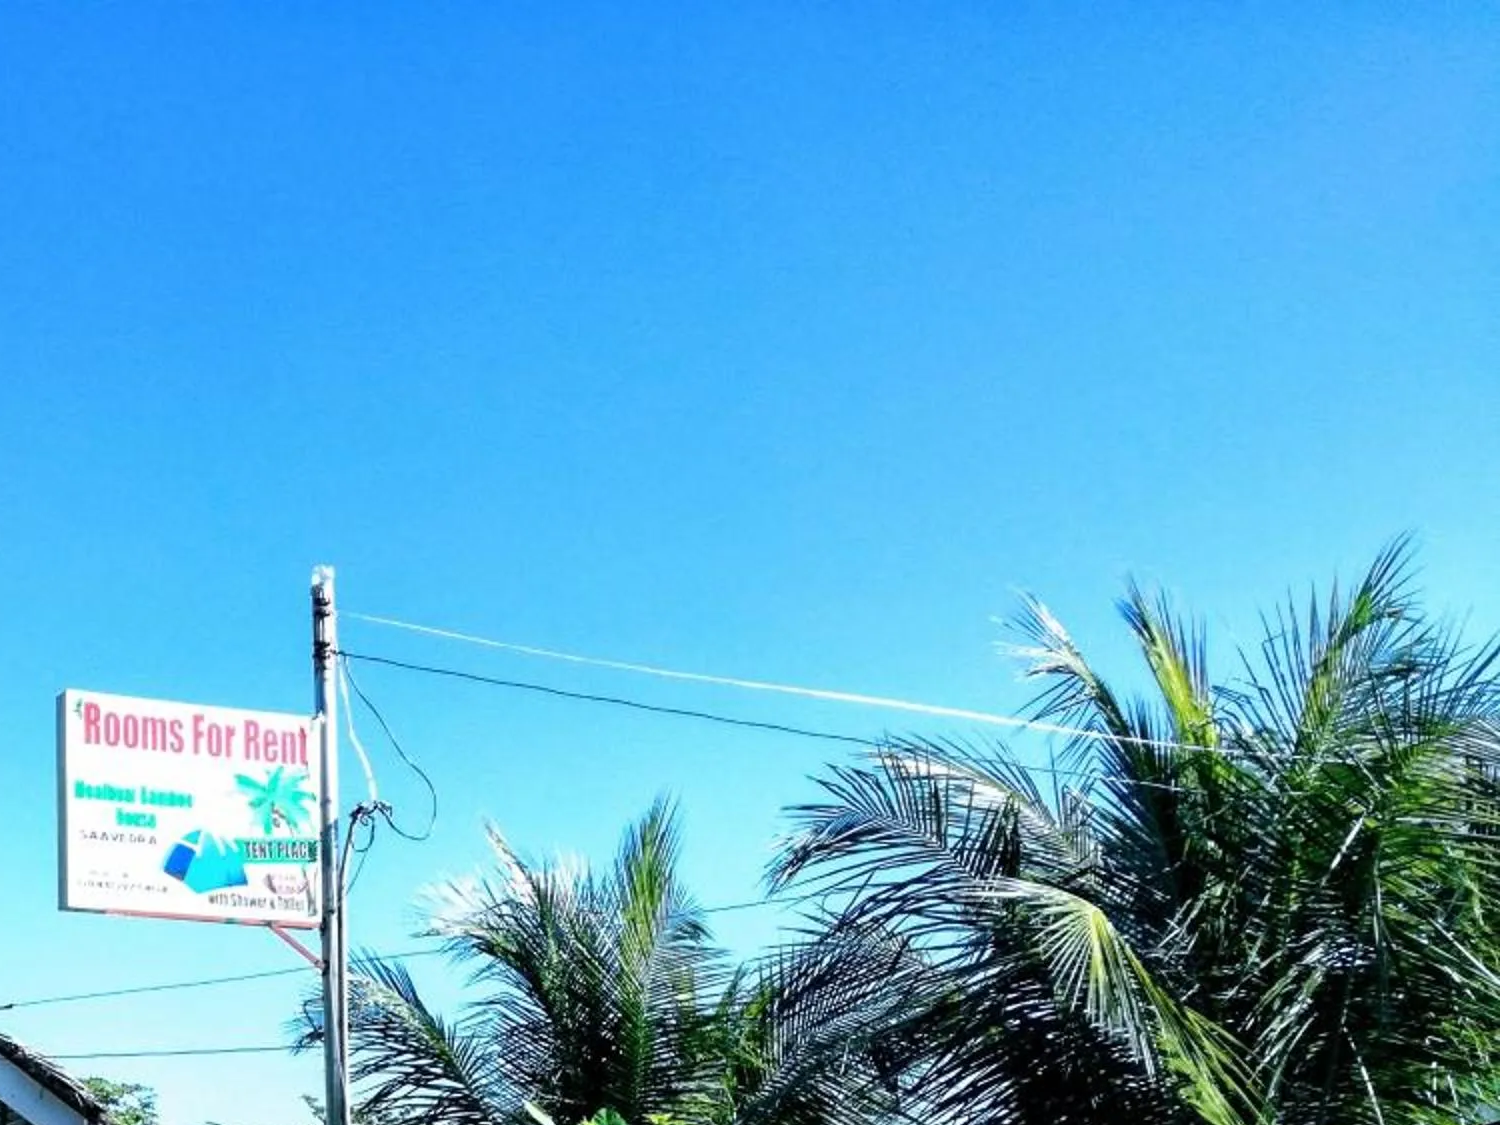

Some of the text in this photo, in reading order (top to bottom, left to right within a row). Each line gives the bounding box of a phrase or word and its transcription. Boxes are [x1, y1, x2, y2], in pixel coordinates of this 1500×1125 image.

[84, 702, 309, 766] Rooms For Rent
[245, 840, 275, 859] TENT
